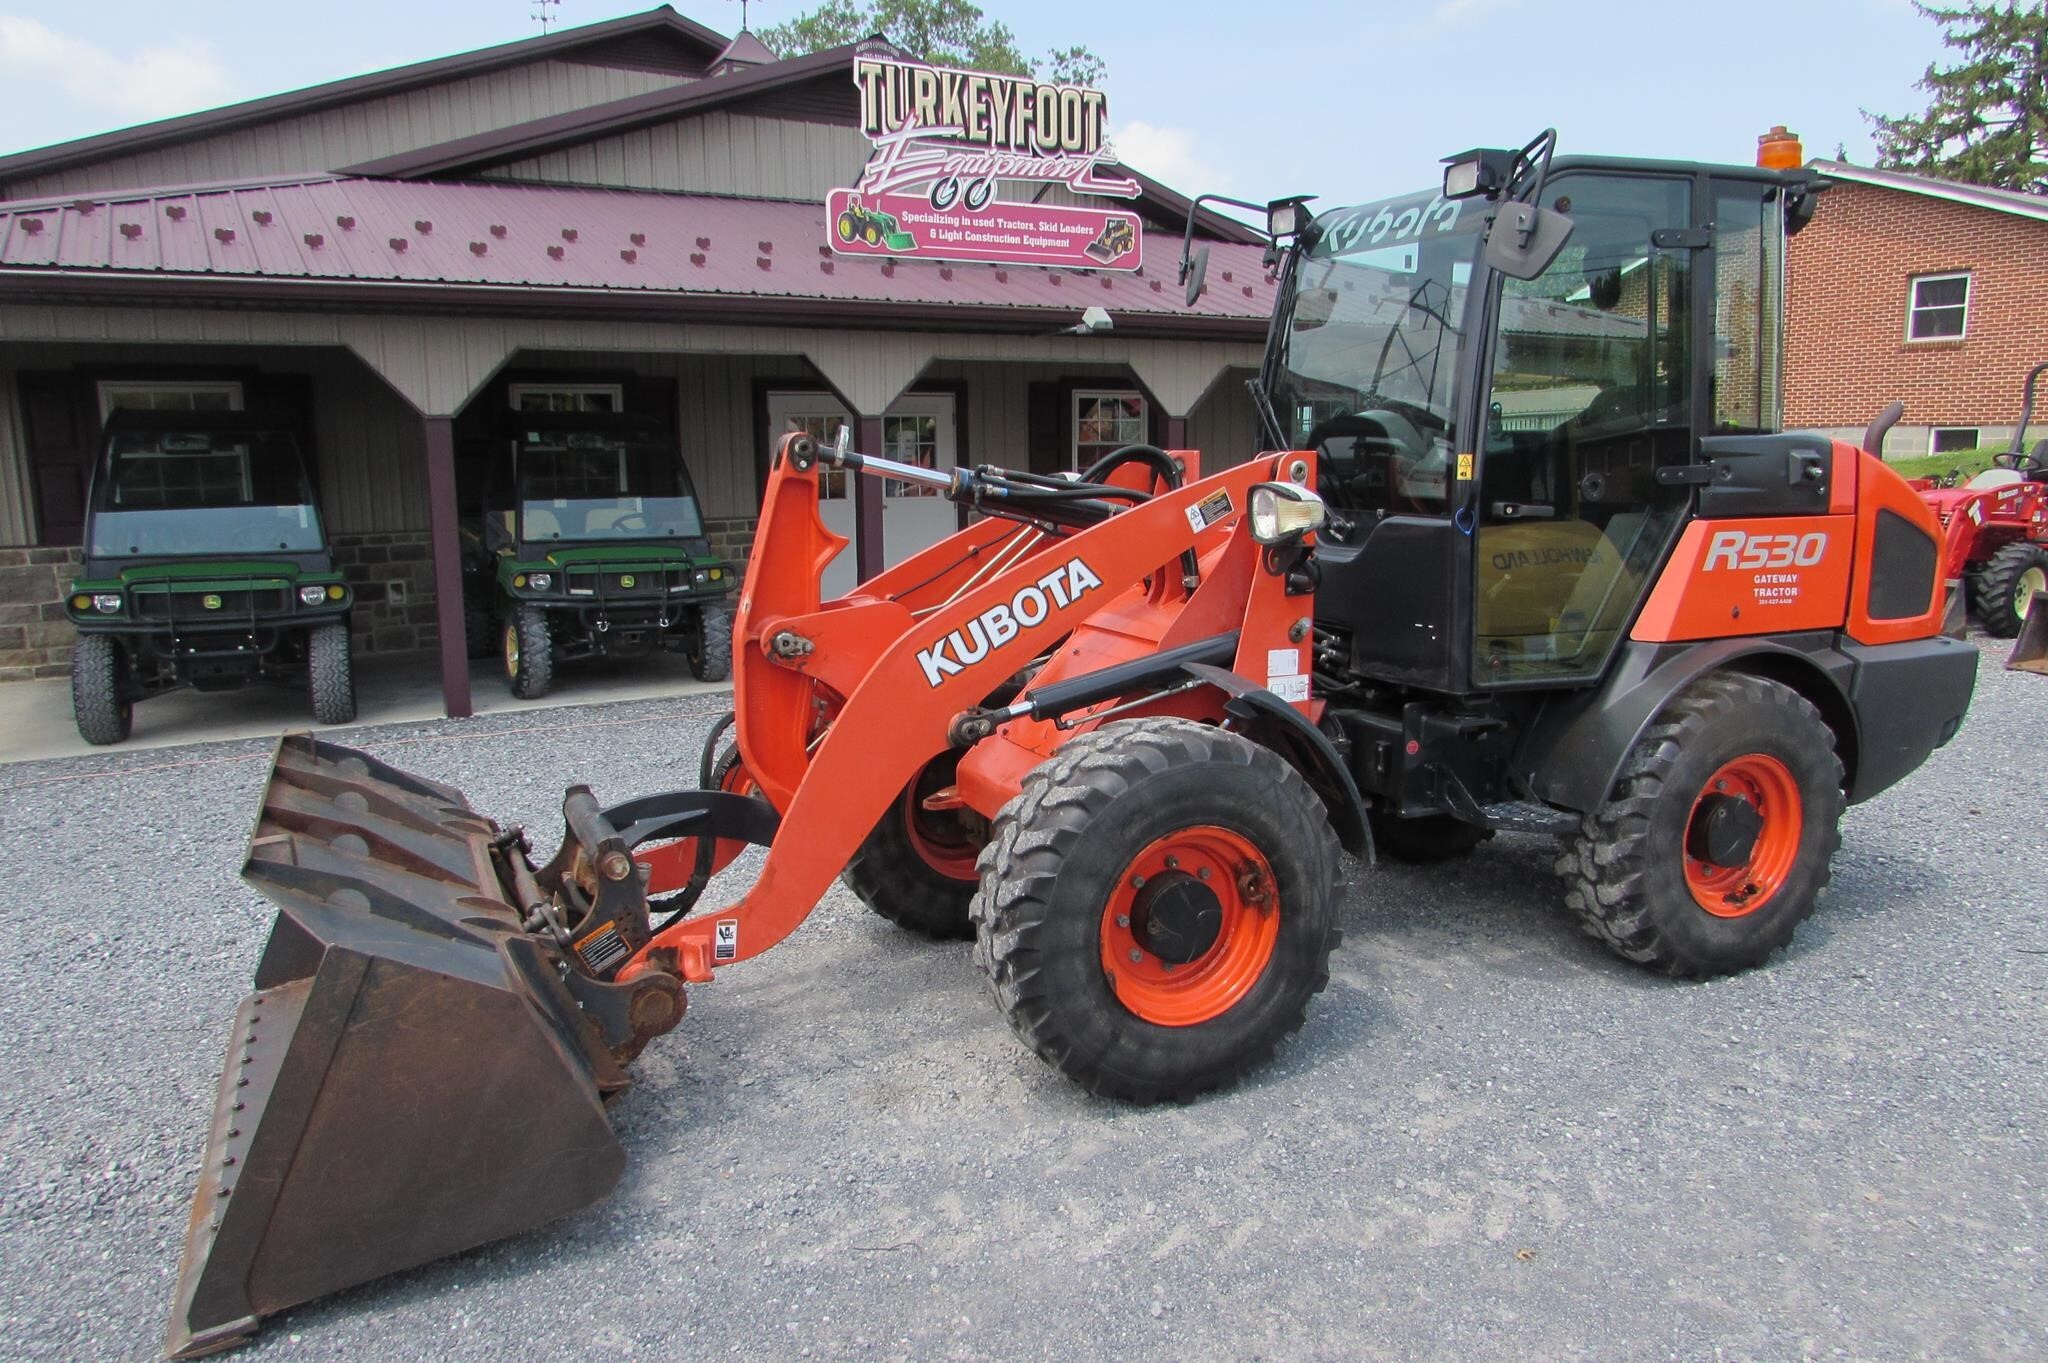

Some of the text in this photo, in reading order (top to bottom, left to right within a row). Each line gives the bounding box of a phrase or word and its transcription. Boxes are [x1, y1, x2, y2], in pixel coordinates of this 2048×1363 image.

[859, 61, 1106, 153] TURKEYFOOT
[866, 118, 1138, 206] Equipment
[901, 210, 960, 227] Specializing
[972, 218, 995, 228] used
[1038, 221, 1058, 233] Skid
[1059, 222, 1095, 235] Loaders
[929, 228, 1070, 248] & Light Construction Equipment
[1702, 531, 1827, 572] R530
[1753, 574, 1798, 584] GATEWAY
[1753, 587, 1798, 597] TRACTOR
[916, 556, 1103, 688] KUBOTA
